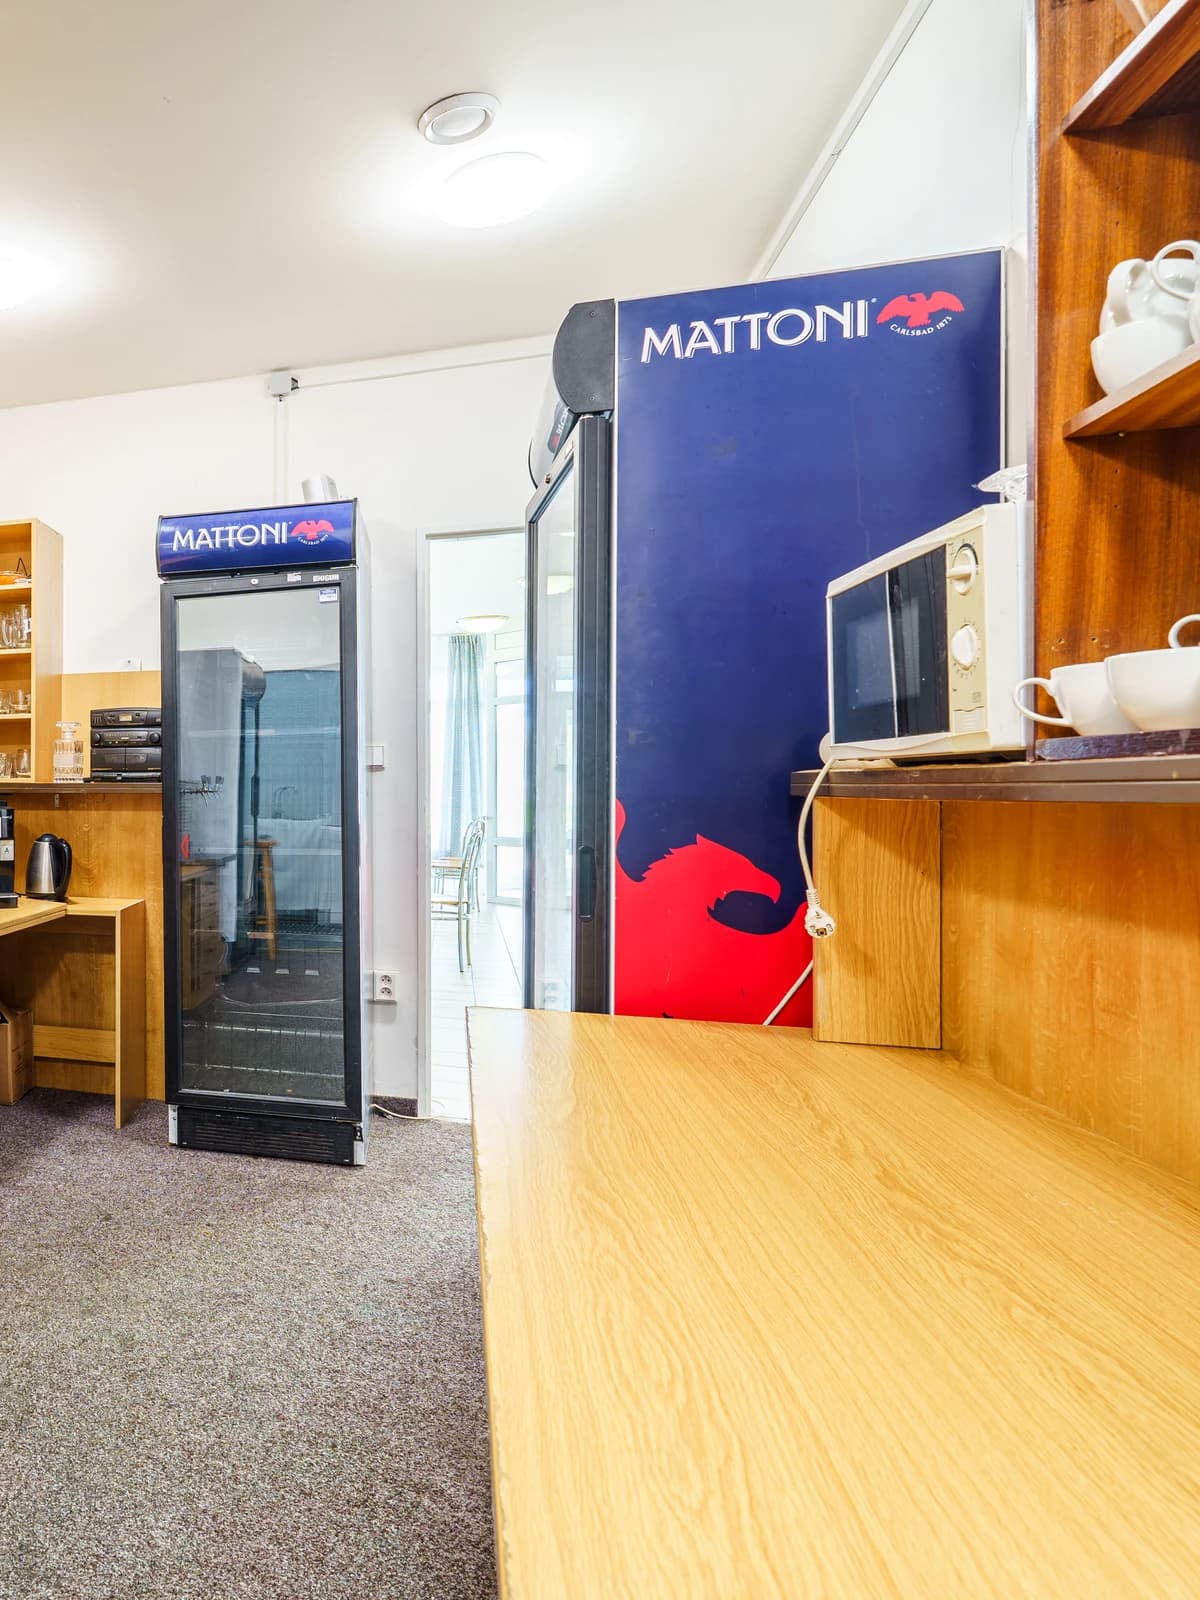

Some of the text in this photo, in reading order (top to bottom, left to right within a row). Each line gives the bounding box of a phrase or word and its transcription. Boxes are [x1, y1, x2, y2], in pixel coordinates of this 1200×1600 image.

[640, 299, 868, 364] MATTONI
[889, 323, 935, 337] CARLSBAD
[172, 522, 287, 552] MATTONI
